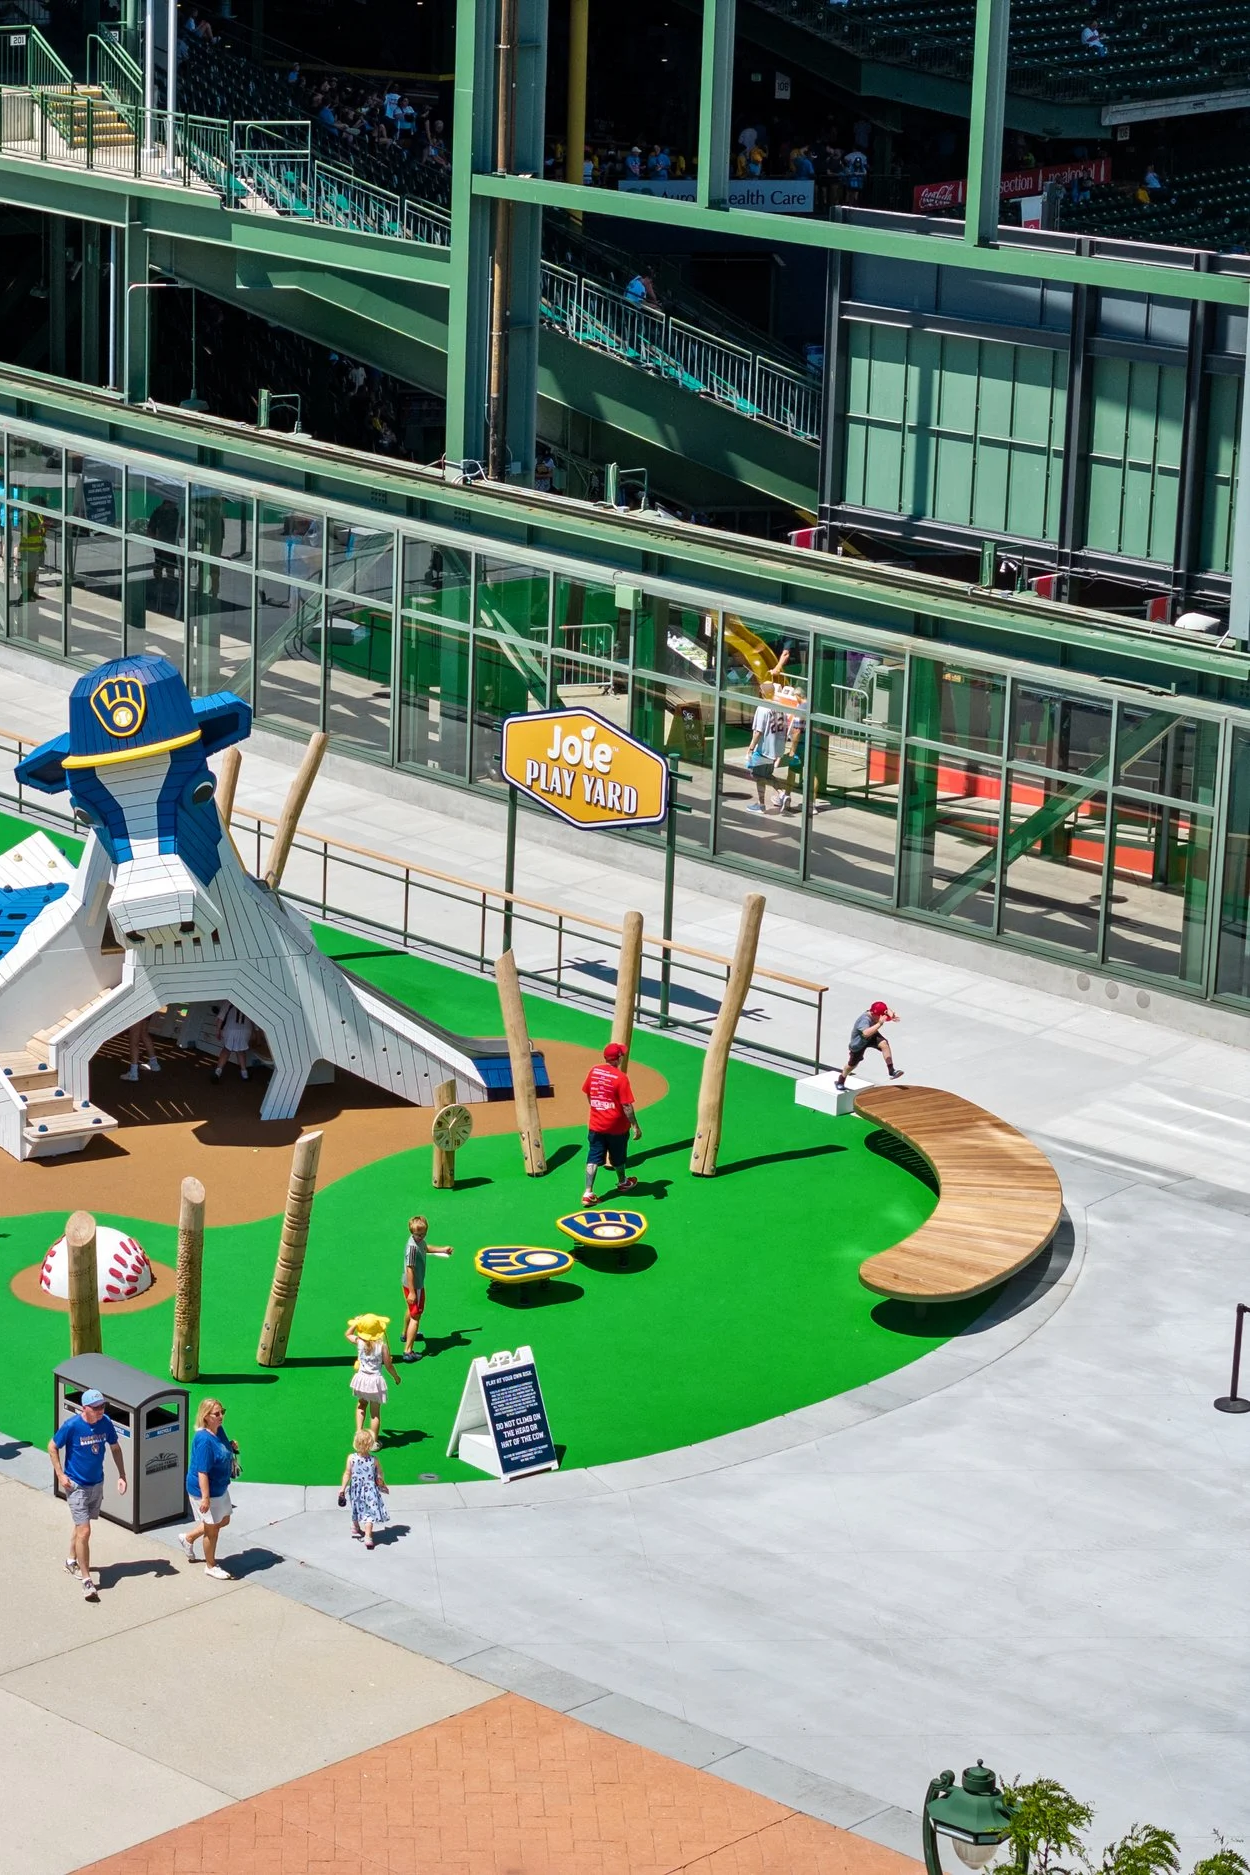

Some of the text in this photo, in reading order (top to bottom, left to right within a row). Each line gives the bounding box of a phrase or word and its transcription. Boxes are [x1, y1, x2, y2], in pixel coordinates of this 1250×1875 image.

[13, 36, 24, 44] 201
[1000, 175, 1033, 194] section
[729, 189, 765, 206] ealth
[771, 190, 807, 206] Care
[547, 725, 614, 774] Joie
[525, 759, 639, 816] PLAY YARD
[502, 1374, 513, 1382] YOUR
[495, 1412, 542, 1431] DO NOT CLIMB ON
[503, 1423, 539, 1439] THE HEAD OR
[500, 1439, 513, 1449] HAT
[512, 1437, 520, 1446] OF
[520, 1434, 532, 1444] THE
